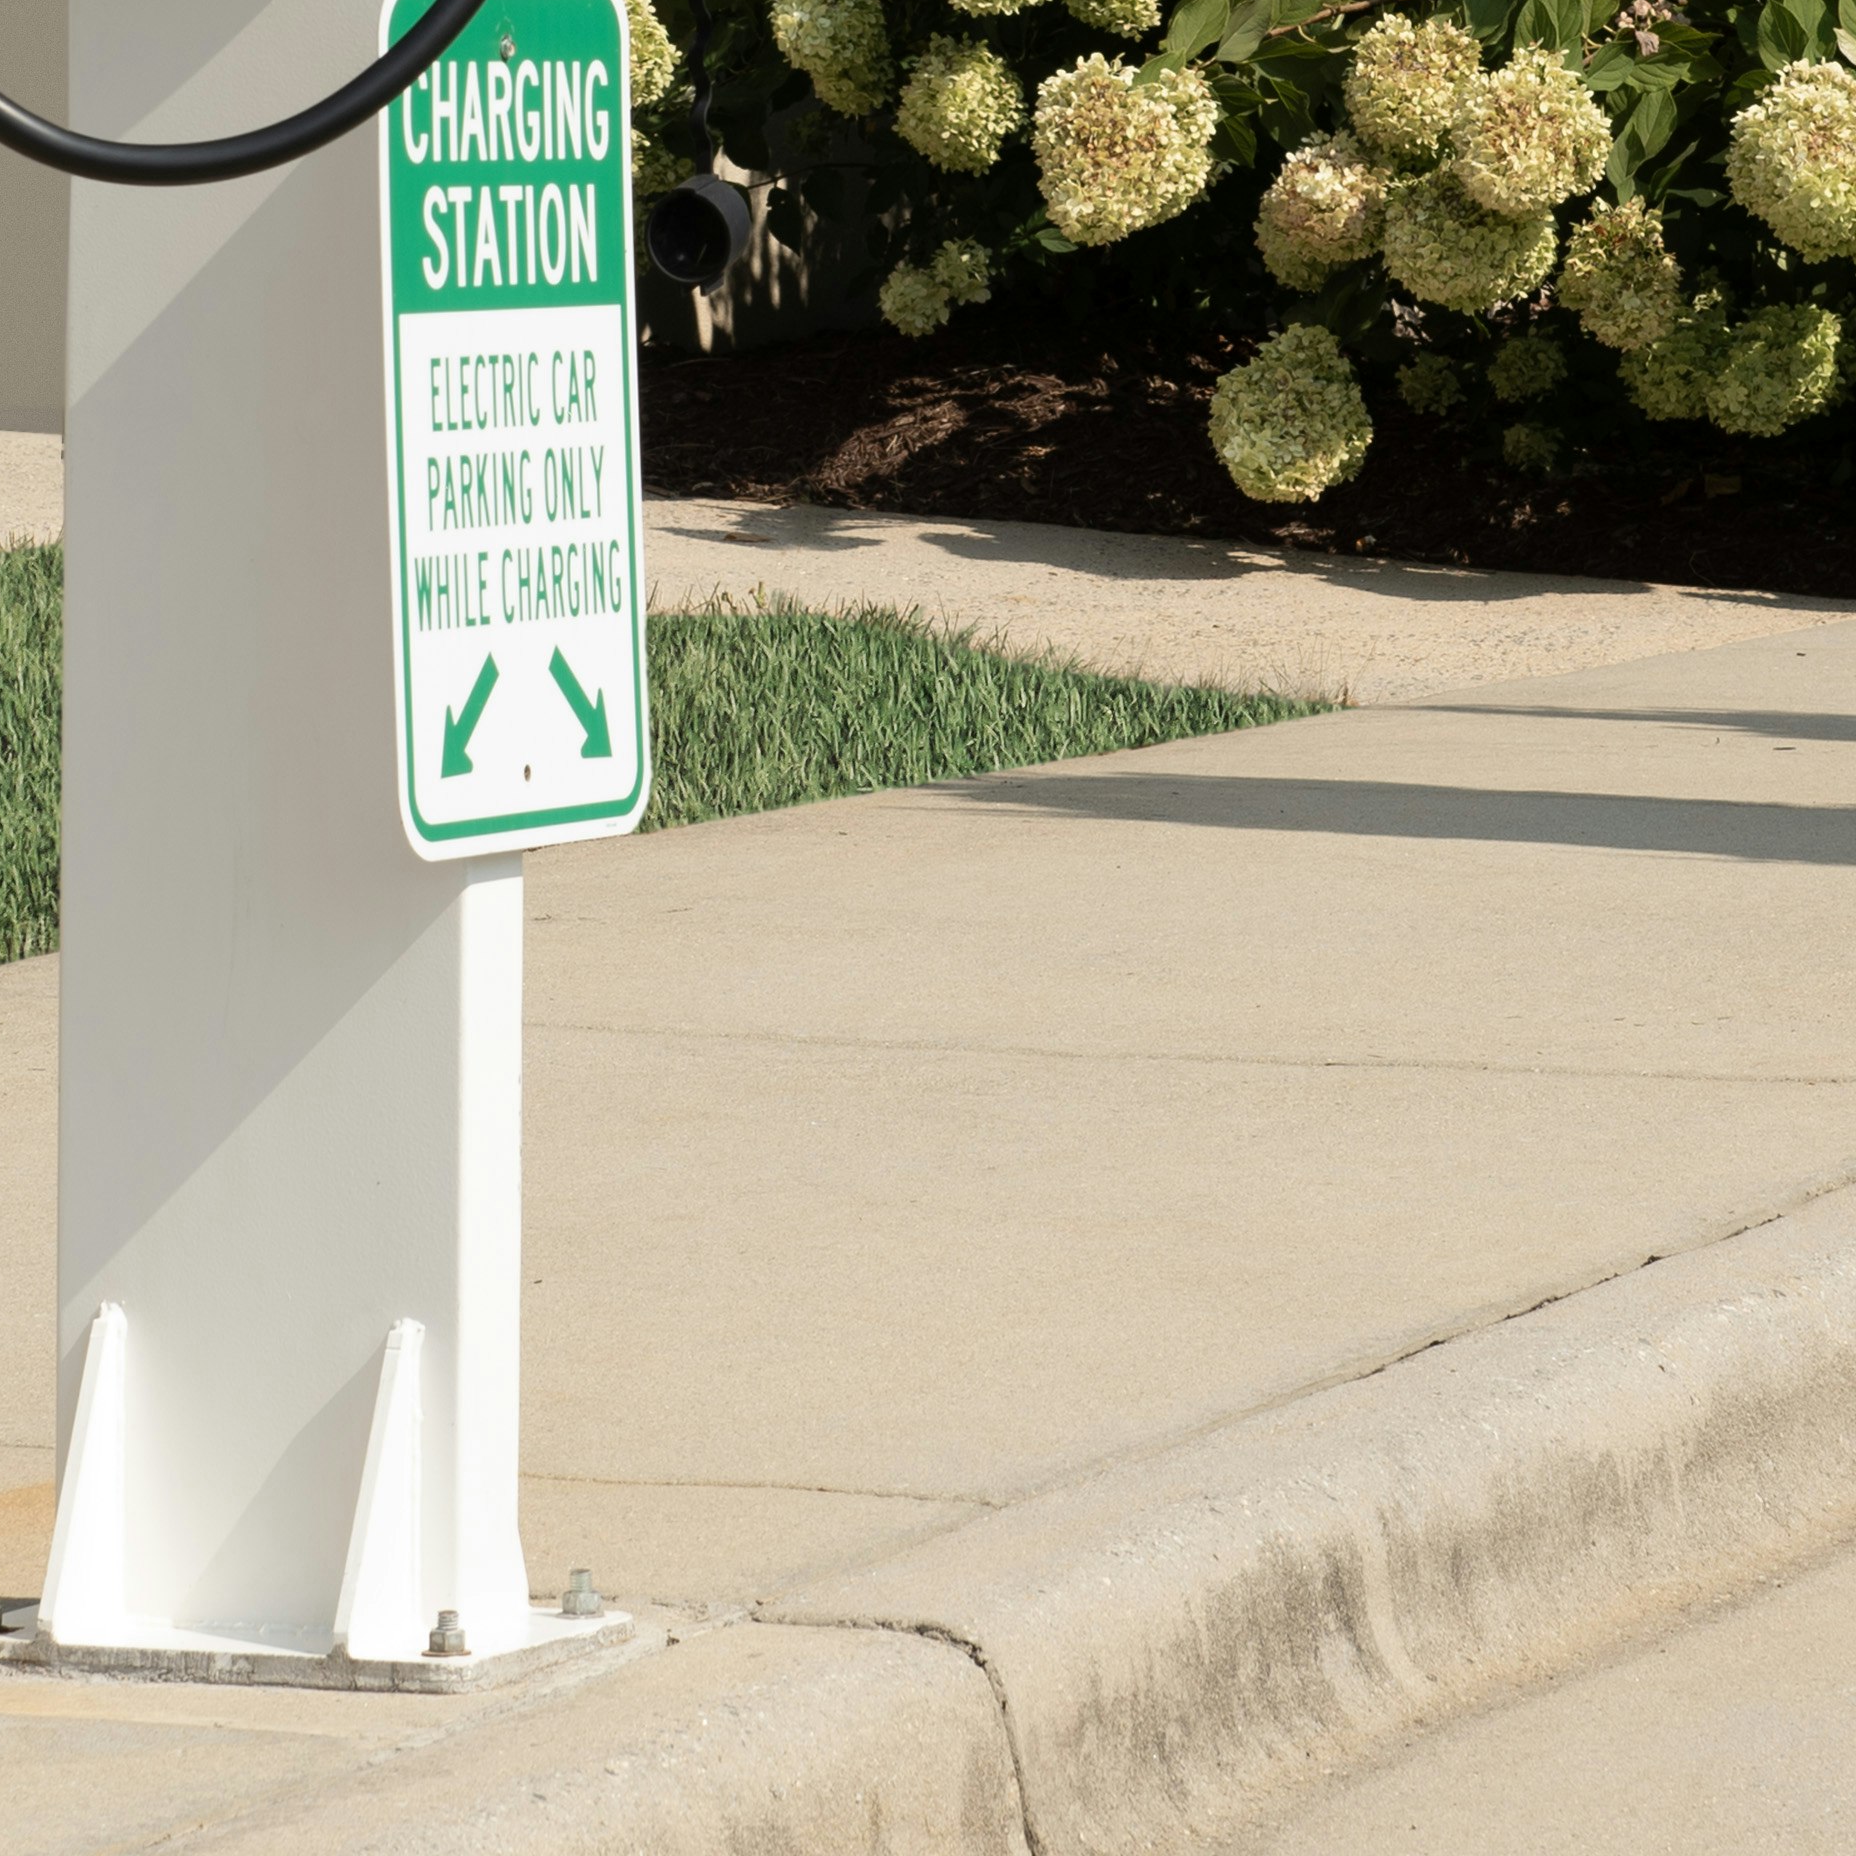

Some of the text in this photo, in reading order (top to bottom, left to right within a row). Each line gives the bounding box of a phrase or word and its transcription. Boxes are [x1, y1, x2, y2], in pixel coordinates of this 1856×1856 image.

[402, 59, 609, 164] CHARGING
[422, 183, 598, 290] STATION
[431, 350, 597, 432] ELECTRIC CAR
[427, 445, 605, 531] PARKING ONLY
[414, 540, 622, 632] WHILE CHARGING
